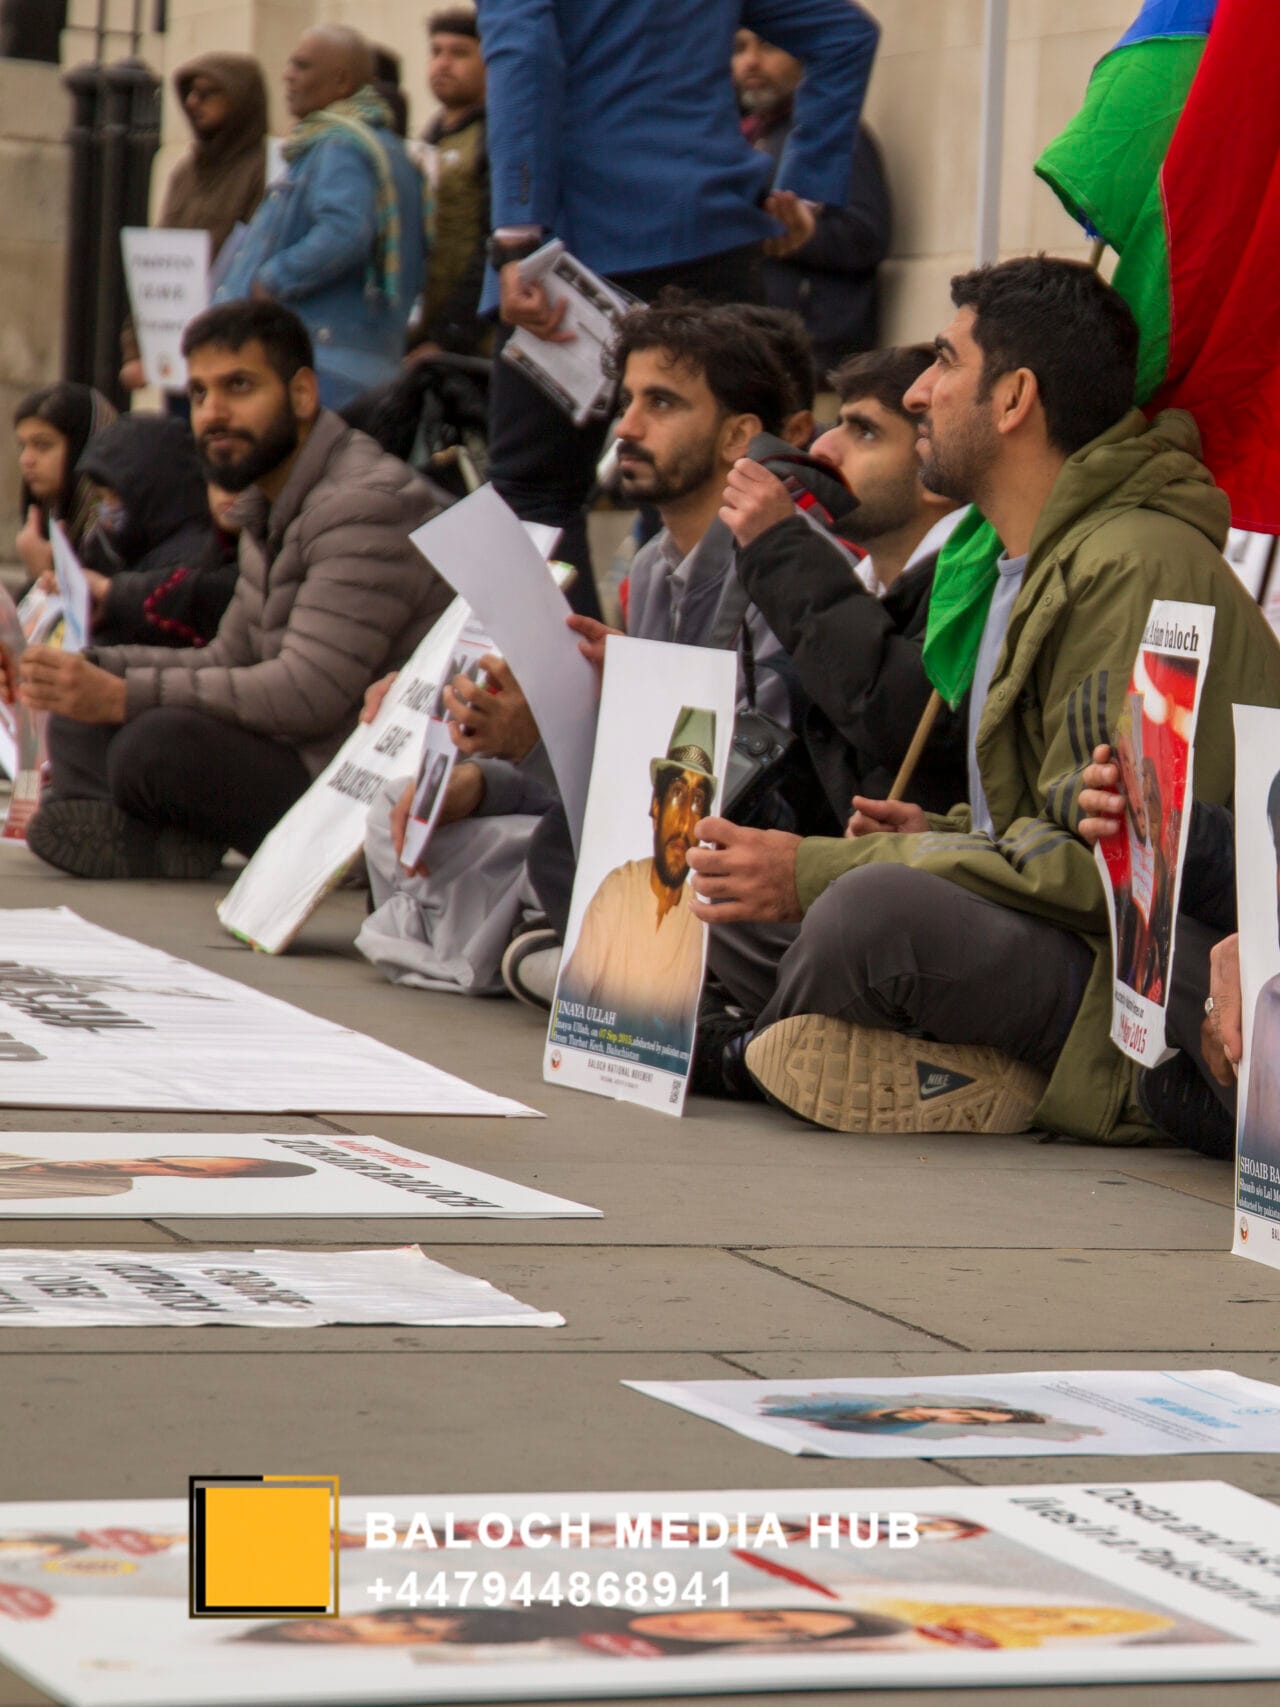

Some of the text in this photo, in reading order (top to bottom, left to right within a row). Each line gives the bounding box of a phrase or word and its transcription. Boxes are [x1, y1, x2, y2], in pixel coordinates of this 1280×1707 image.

[1164, 622, 1199, 652] baloch
[558, 1000, 617, 1025] INAYA ULLAH
[588, 1058, 606, 1071] BALOCH
[607, 1062, 630, 1078] NATIONAL
[631, 1070, 653, 1083] MOVEMENT
[927, 1073, 952, 1085] NIKE
[263, 1138, 504, 1208] ZUBAIR BALOCH
[1240, 1156, 1268, 1181] SHOAIB
[1263, 1185, 1272, 1199] Lal
